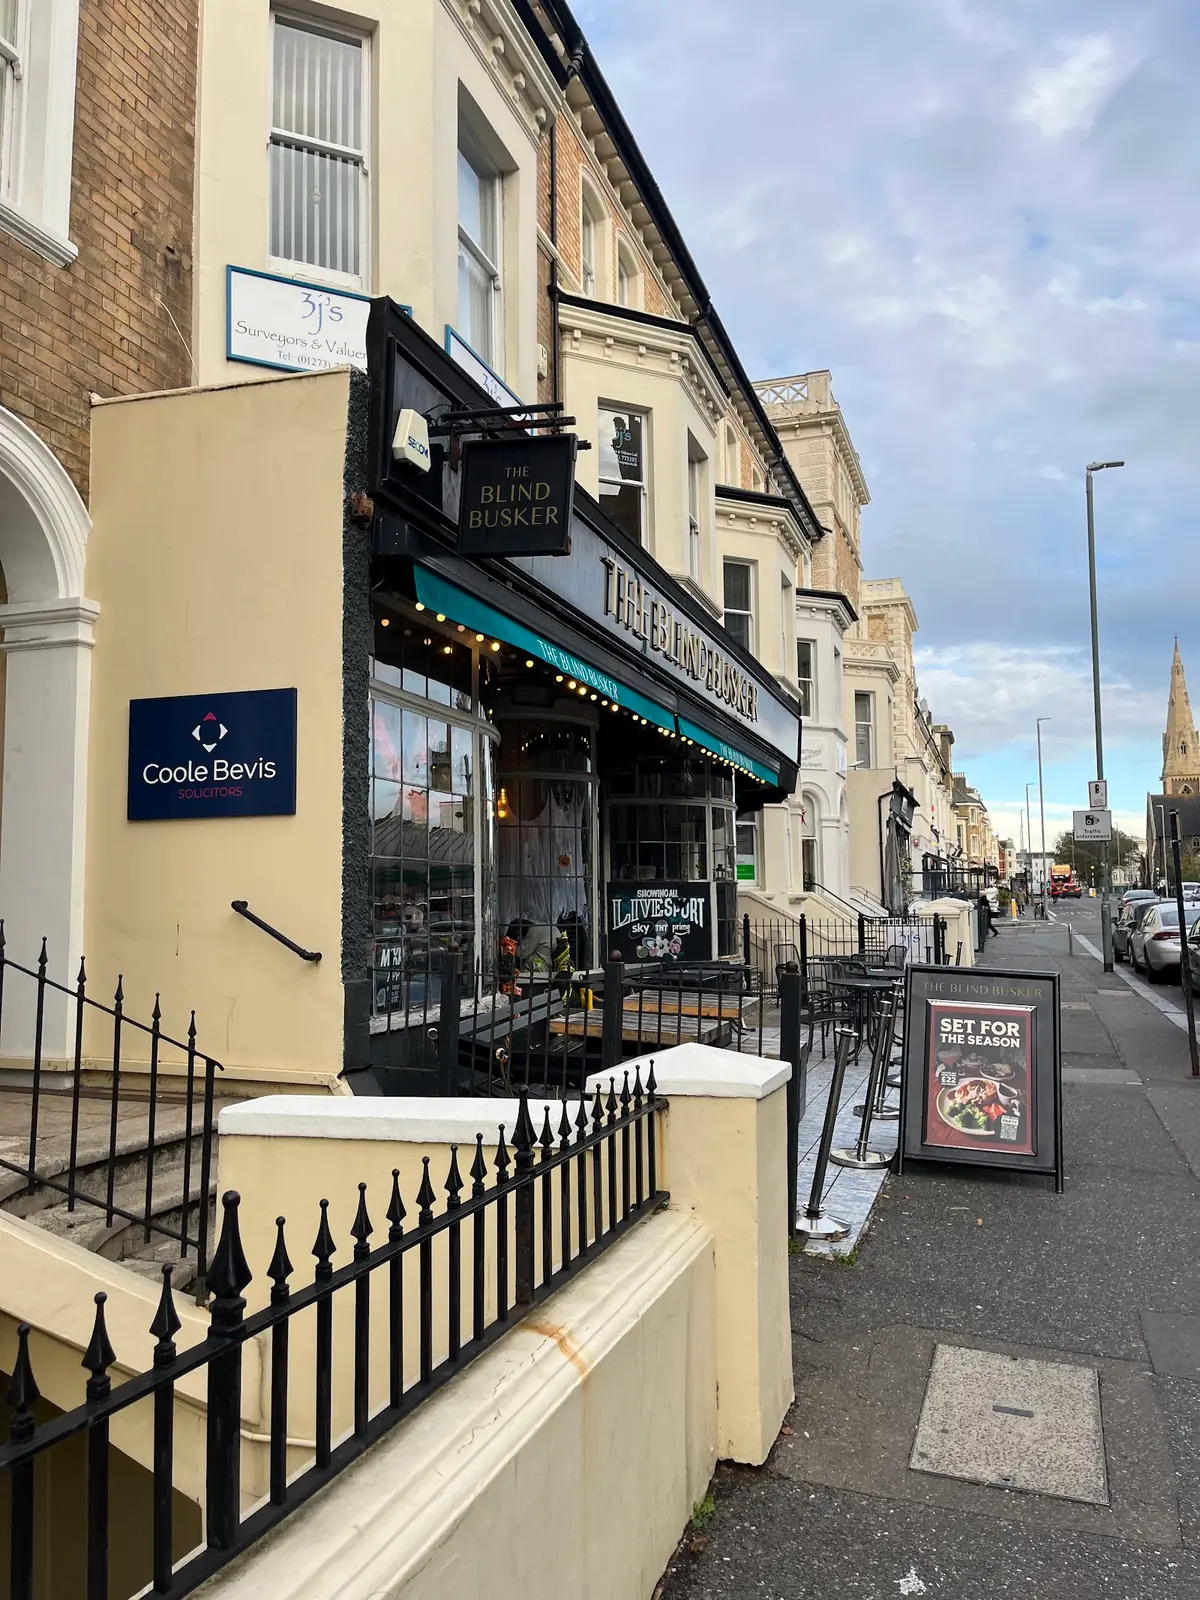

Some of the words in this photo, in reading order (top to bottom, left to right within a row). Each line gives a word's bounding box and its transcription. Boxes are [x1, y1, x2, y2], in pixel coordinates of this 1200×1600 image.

[301, 291, 344, 335] 3j's
[235, 320, 308, 348] Surveyors
[311, 339, 322, 350] &
[325, 339, 367, 360] Valuer
[276, 350, 294, 362] Tel:
[297, 354, 331, 369] (01273)
[407, 436, 429, 458] SECOM
[504, 465, 530, 479] THE
[480, 481, 551, 504] BLIND
[468, 504, 559, 529] BUSKER
[599, 555, 651, 642] THE
[650, 599, 709, 683] BLIND
[706, 647, 760, 723] BUSKER
[537, 639, 560, 667] THE
[559, 651, 589, 682] BLIND
[588, 668, 619, 701] BUSKER
[143, 760, 208, 785] Coole
[213, 757, 277, 781] Bevis
[178, 786, 243, 799] SOLICITORS
[637, 889, 668, 898] SHOWING
[668, 889, 679, 898] ALL
[612, 898, 664, 930] LIVE
[632, 922, 650, 935] sky
[655, 924, 668, 932] TNT
[672, 922, 691, 933] prime
[923, 980, 945, 992] THE
[949, 983, 989, 995] BLIND
[992, 985, 1043, 998] BUSKER
[940, 1018, 976, 1032] SET
[980, 1020, 1021, 1037] FOR
[940, 1033, 965, 1044] THE
[967, 1035, 1021, 1048] SEASON
